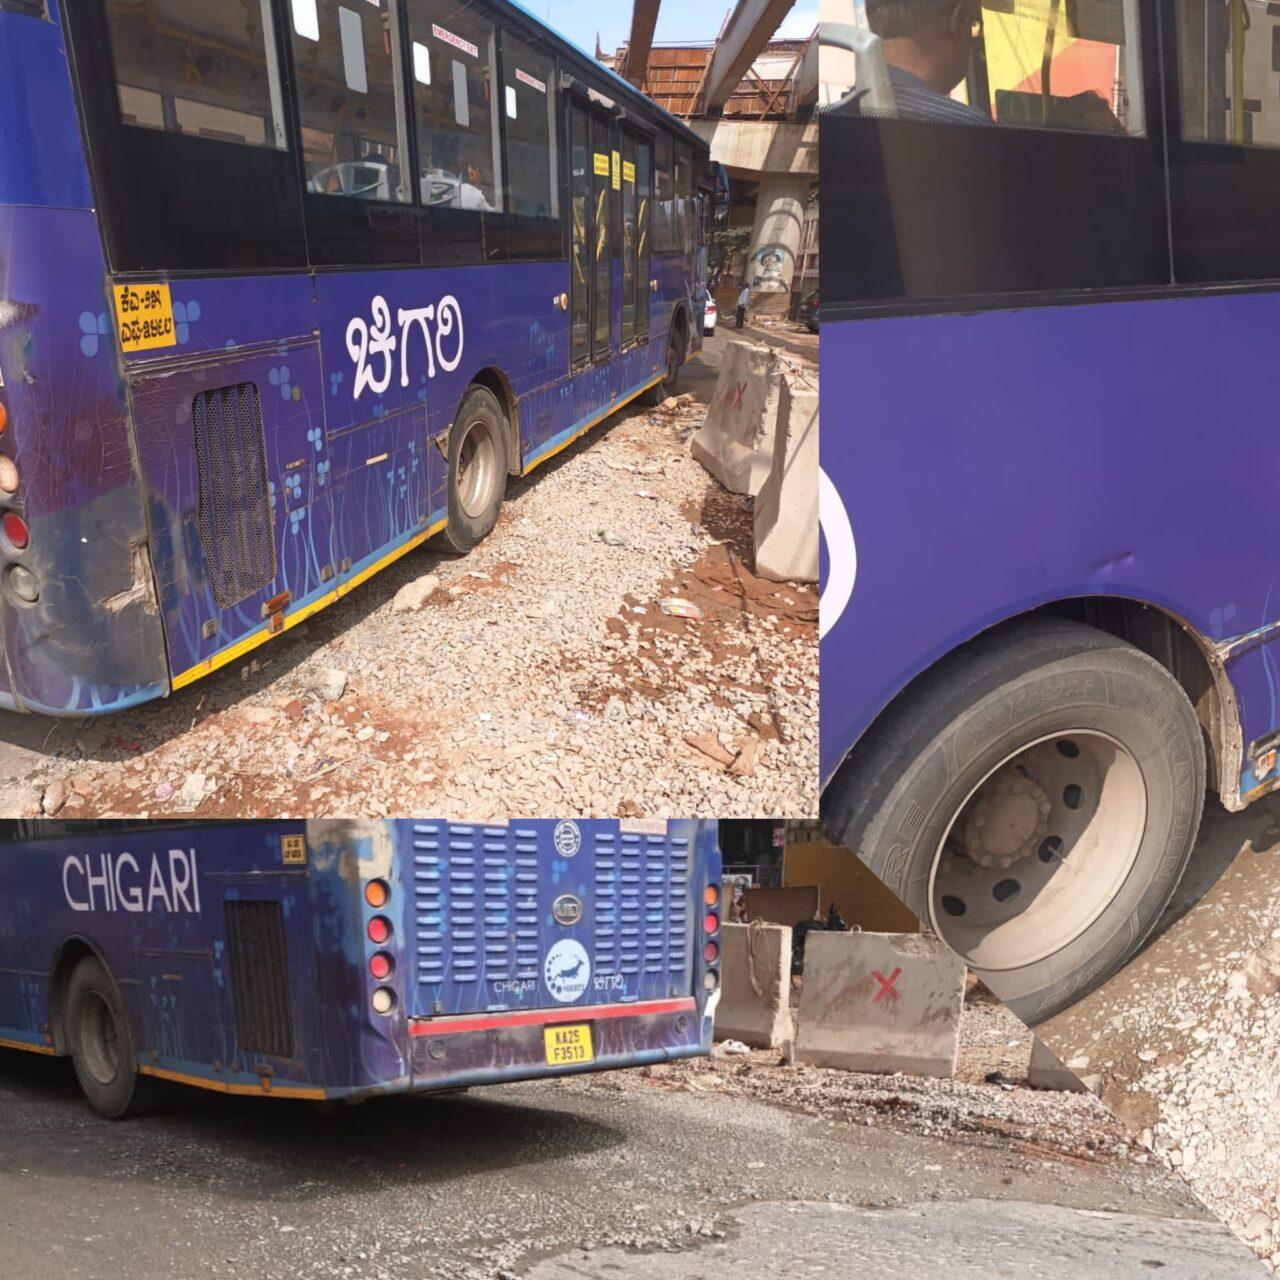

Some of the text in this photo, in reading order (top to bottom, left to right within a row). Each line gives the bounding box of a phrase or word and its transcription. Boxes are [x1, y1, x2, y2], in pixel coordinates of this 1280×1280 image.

[62, 848, 200, 914] CHIGARI
[493, 979, 536, 993] CHIGARI
[555, 1029, 580, 1045] KA25
[553, 1047, 585, 1061] F3513
